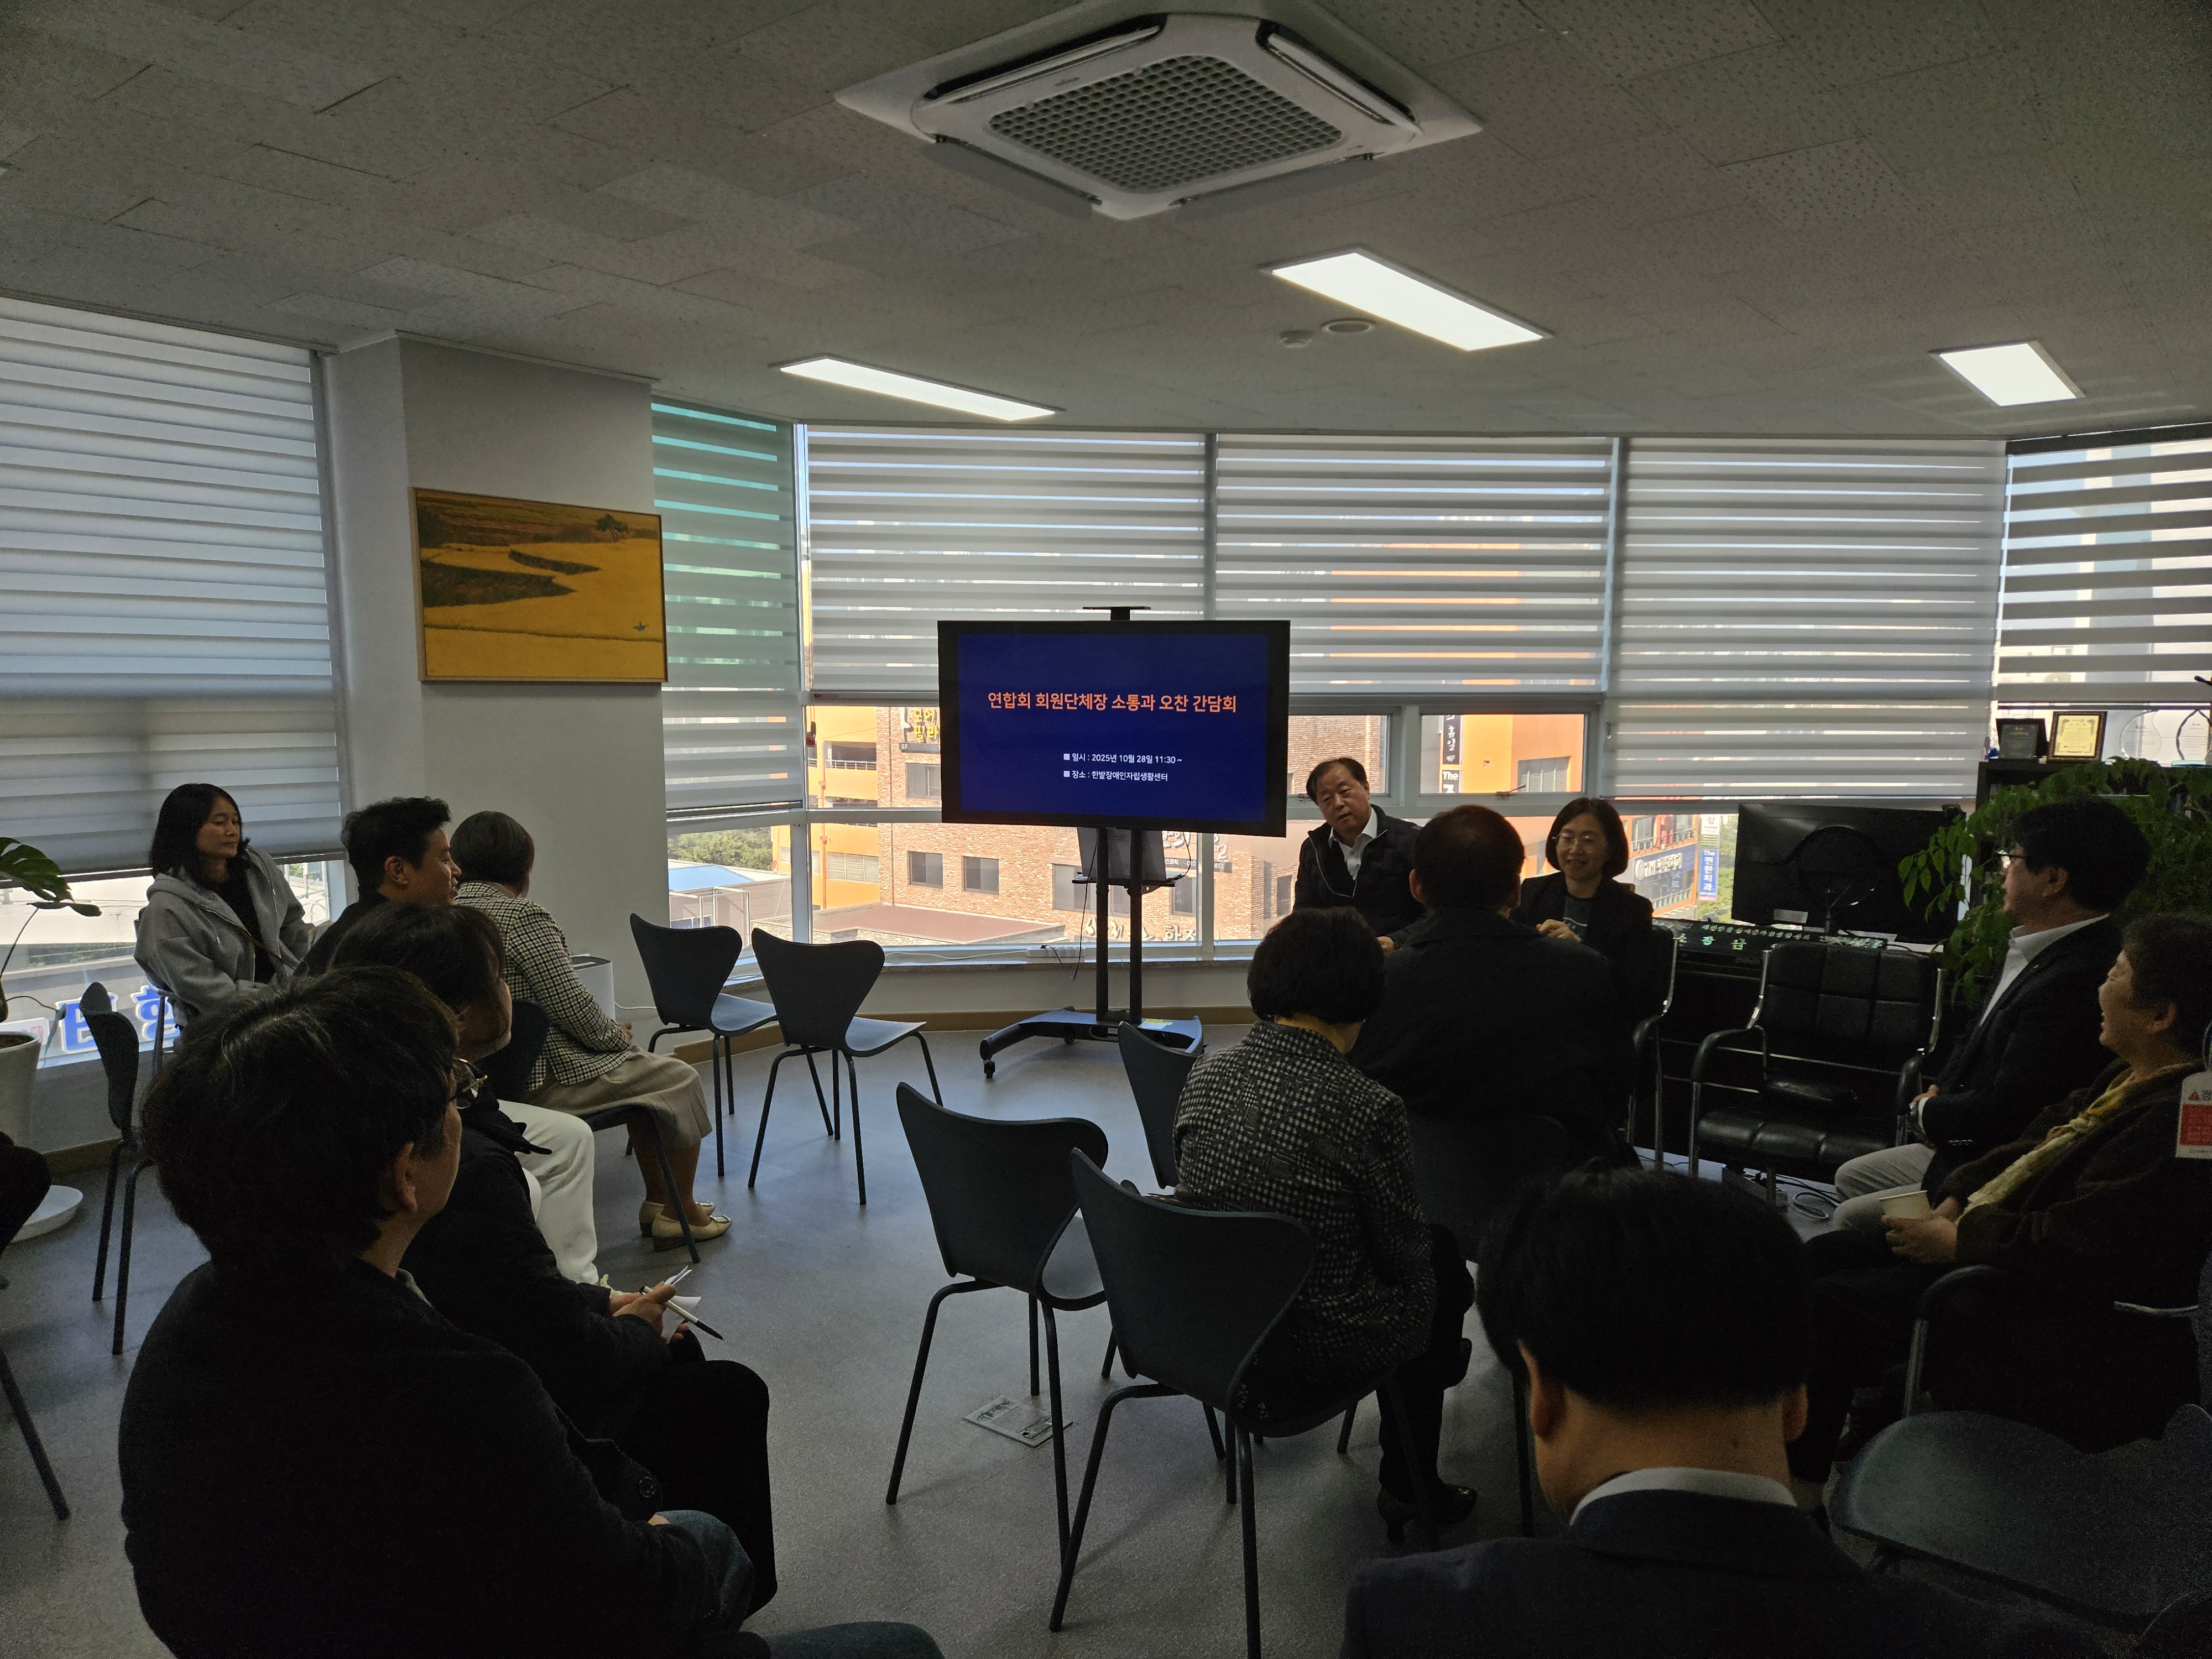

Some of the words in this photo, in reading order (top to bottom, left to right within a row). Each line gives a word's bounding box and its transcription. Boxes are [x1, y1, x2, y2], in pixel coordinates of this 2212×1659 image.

[988, 692, 1030, 709] 연합회
[1036, 693, 1108, 711] 회원단체장
[1112, 695, 1155, 711] 소통과
[1159, 695, 1188, 712] 오찬
[1193, 695, 1236, 712] 간담회
[1072, 753, 1086, 761] 일시
[1092, 754, 1117, 763] 2025년
[1119, 755, 1134, 763] 10월
[1136, 755, 1152, 764] 28일
[1072, 770, 1086, 779] 장소
[1443, 771, 1459, 780] The
[1704, 857, 1714, 891] 편한치과
